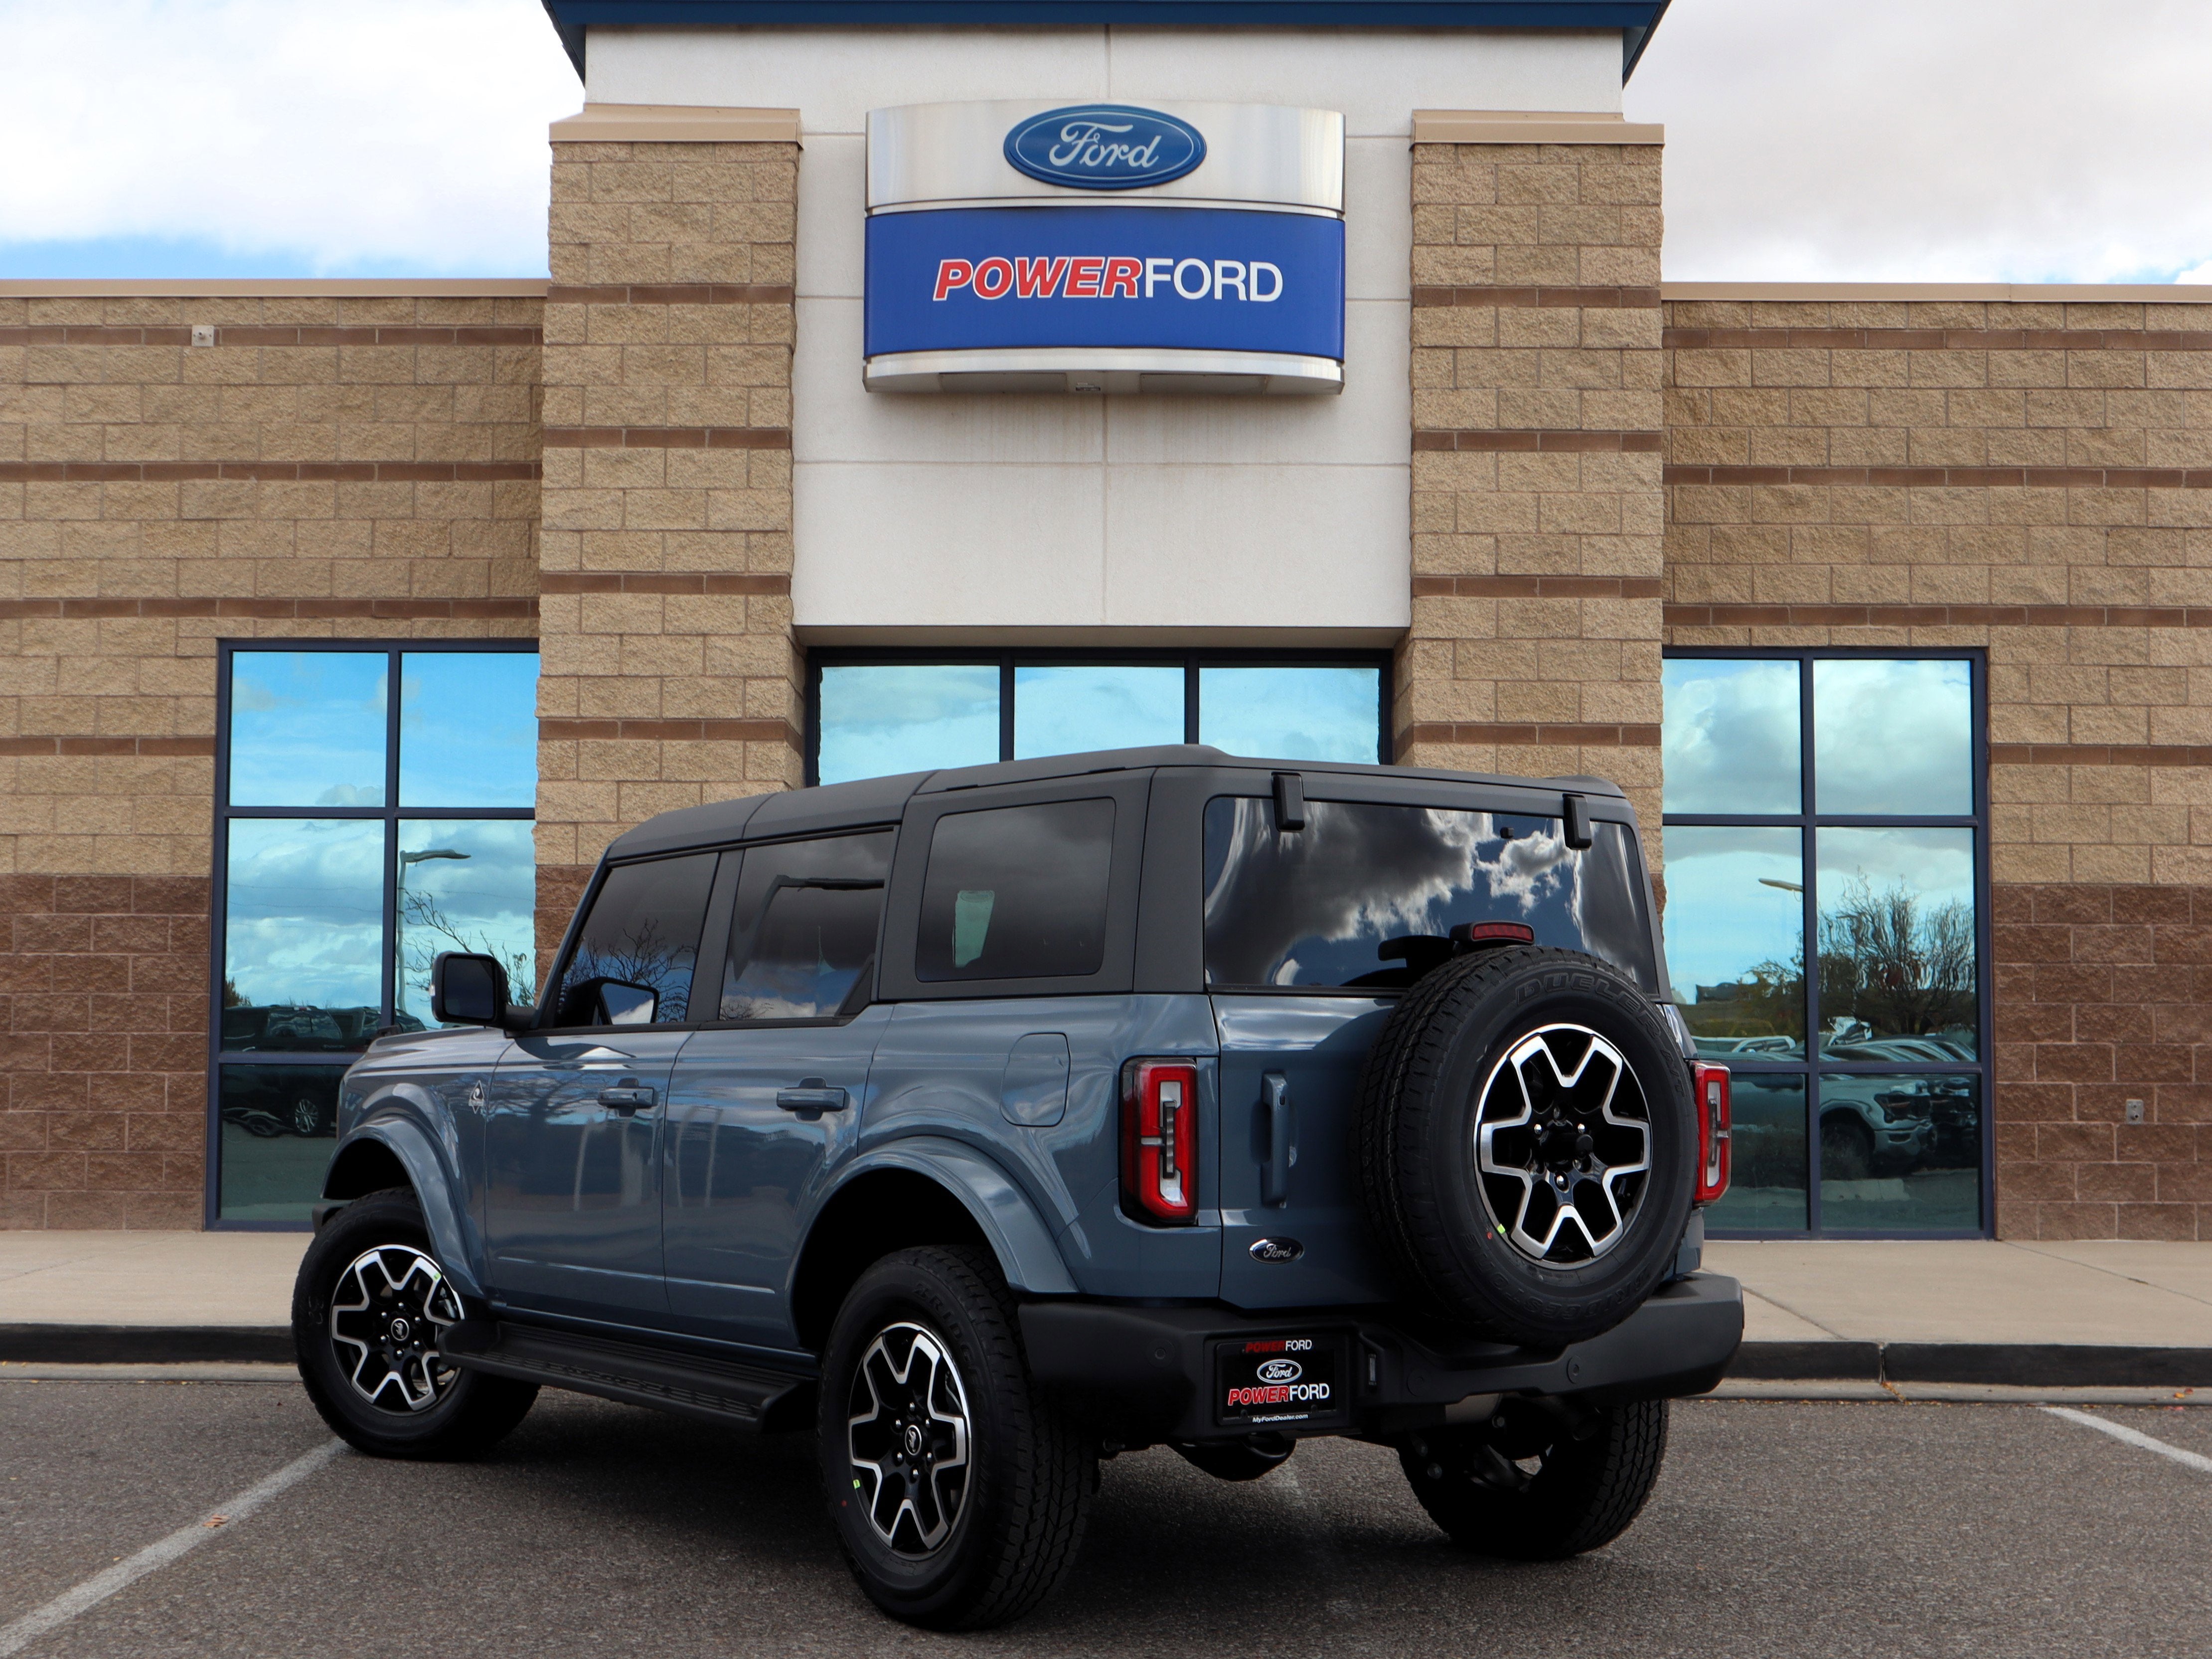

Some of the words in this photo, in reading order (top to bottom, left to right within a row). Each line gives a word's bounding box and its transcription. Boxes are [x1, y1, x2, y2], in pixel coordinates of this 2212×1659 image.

[1049, 121, 1162, 168] Ford
[933, 256, 1283, 302] POWERFORD
[1515, 972, 1661, 1040] DUELER
[1263, 1242, 1292, 1259] Ford
[1265, 1364, 1292, 1379] Ford
[1228, 1383, 1330, 1406] POWERFORD
[1252, 1412, 1308, 1423] MyFordDealer.com
